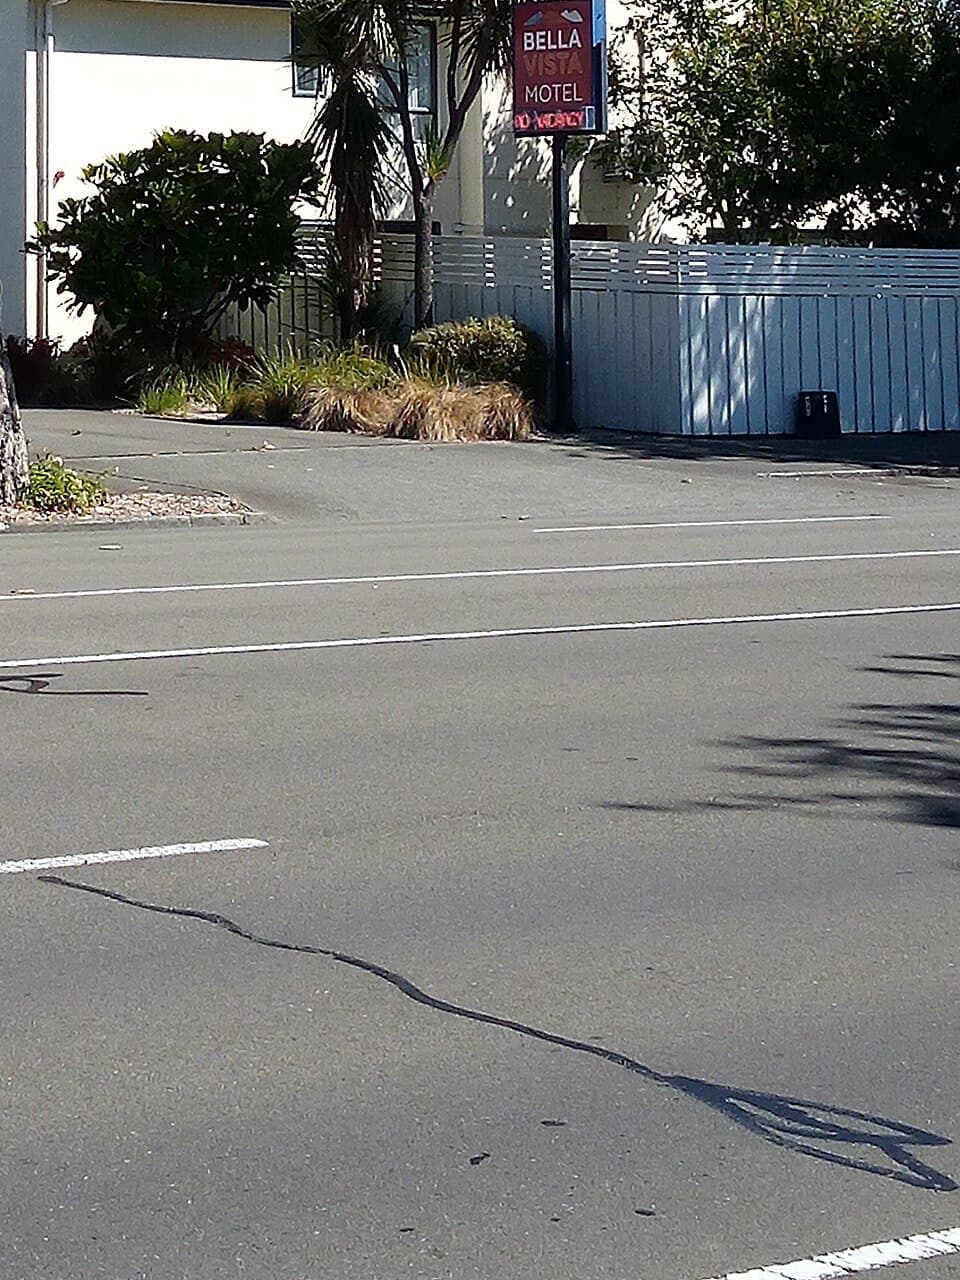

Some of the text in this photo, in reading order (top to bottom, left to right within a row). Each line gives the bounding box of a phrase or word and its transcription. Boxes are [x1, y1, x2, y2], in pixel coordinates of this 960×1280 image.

[523, 29, 582, 51] BELLA
[523, 52, 582, 75] VISTA
[525, 83, 583, 103] MOTEL
